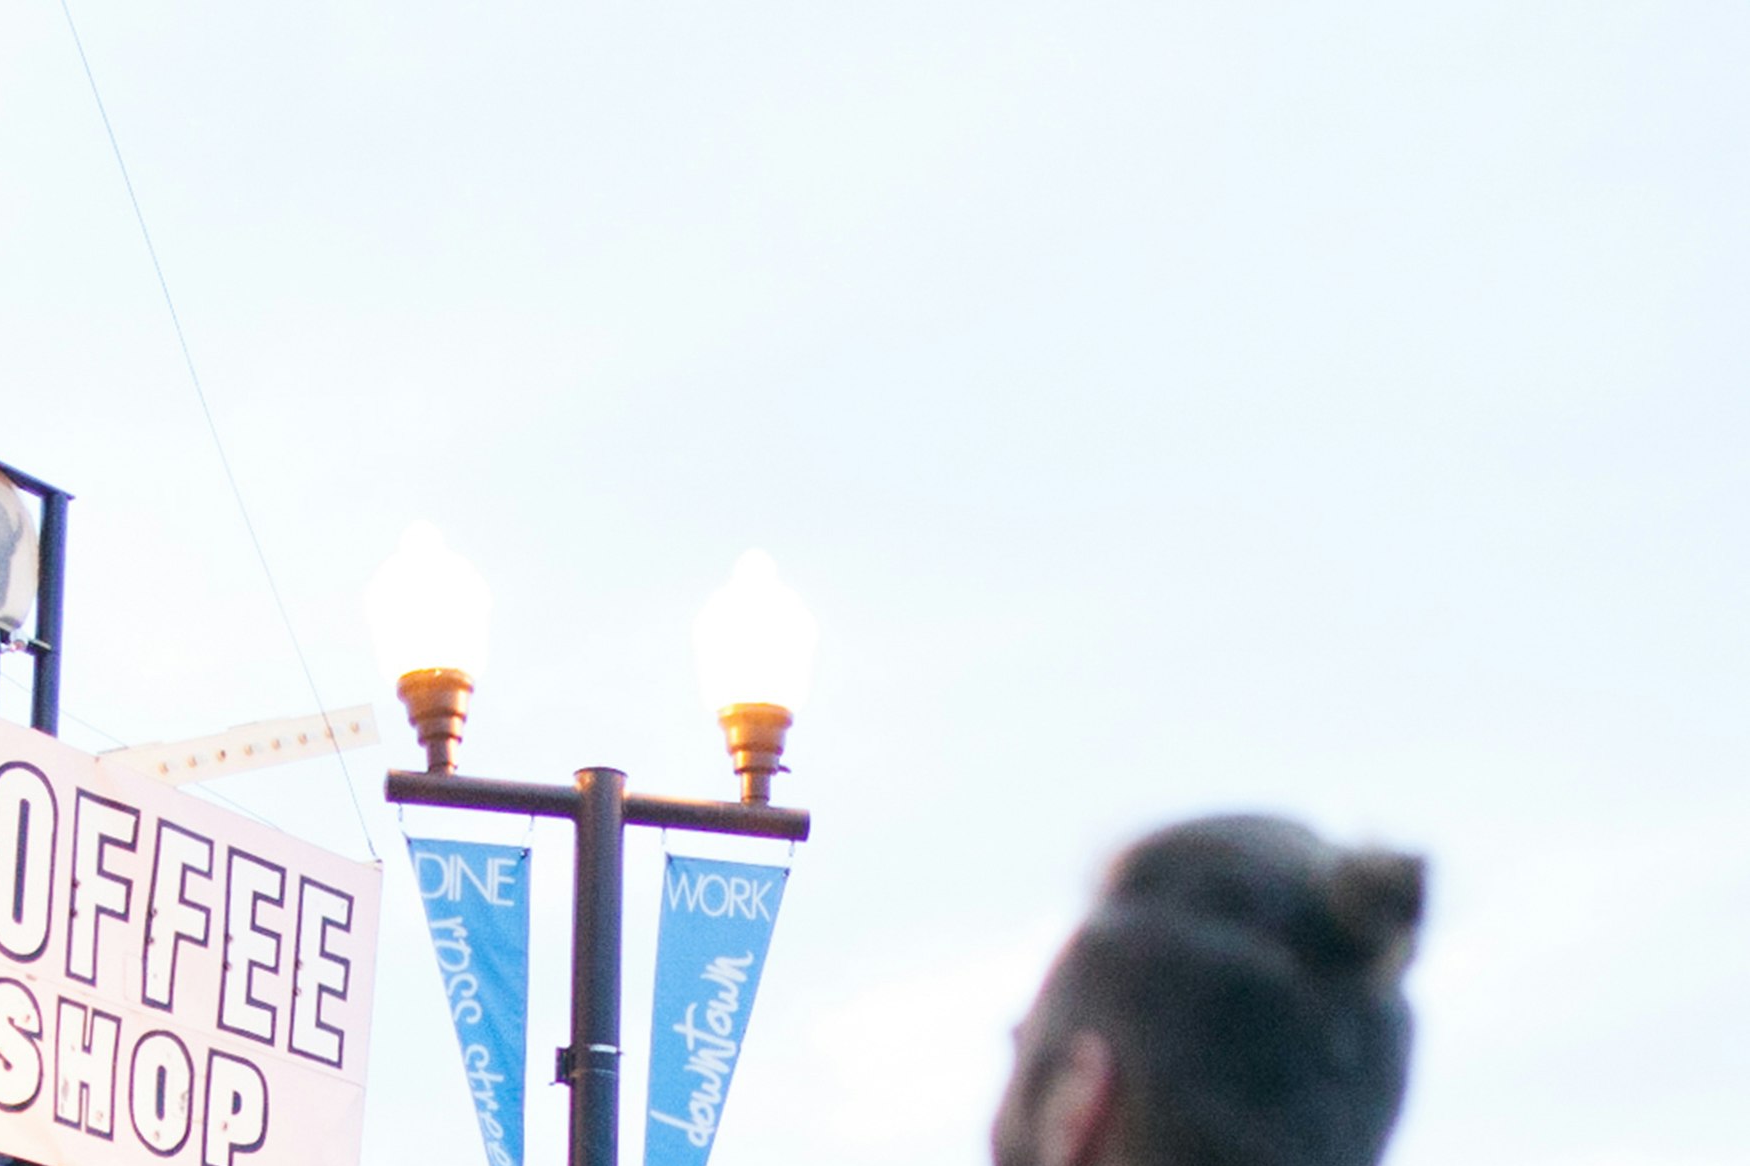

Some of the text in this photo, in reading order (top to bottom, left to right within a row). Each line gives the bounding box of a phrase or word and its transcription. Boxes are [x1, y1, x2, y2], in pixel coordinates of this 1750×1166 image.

[413, 851, 518, 907] DINE
[666, 872, 773, 922] WORK
[649, 950, 754, 1148] downtown
